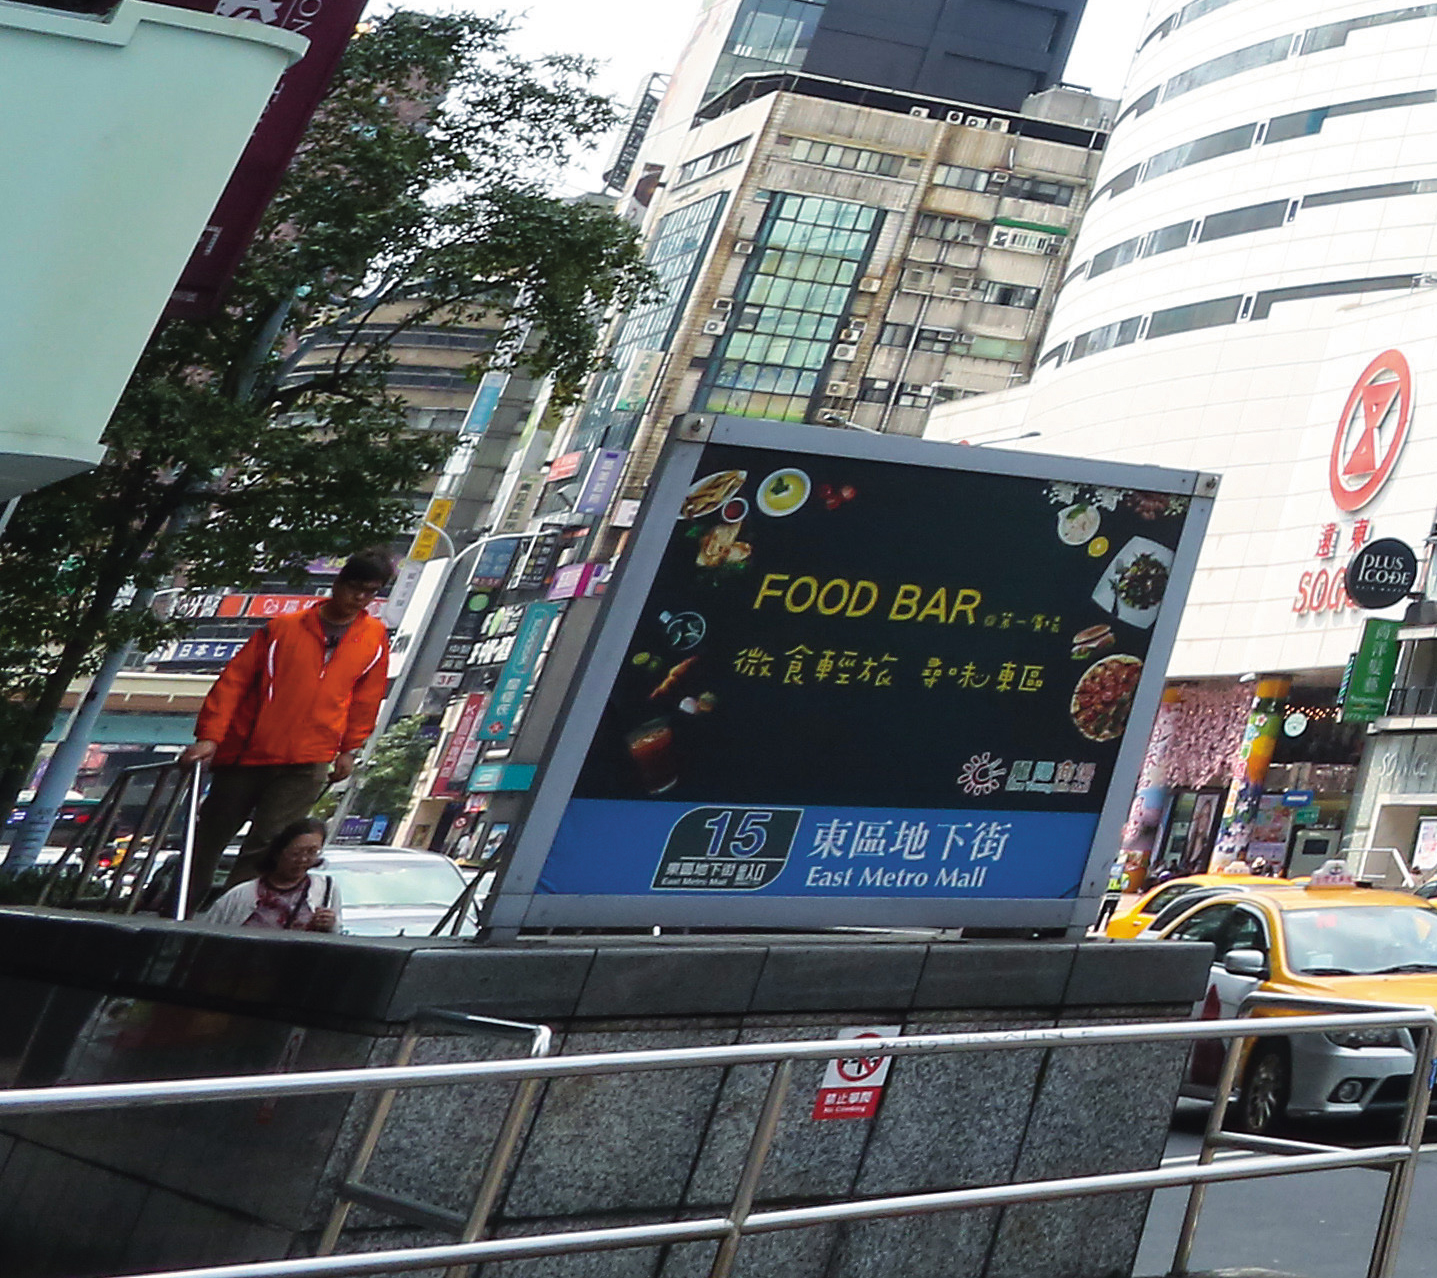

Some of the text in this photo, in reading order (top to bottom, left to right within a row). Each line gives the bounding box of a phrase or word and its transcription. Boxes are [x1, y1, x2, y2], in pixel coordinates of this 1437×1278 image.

[1314, 518, 1375, 559] 遠東
[752, 573, 983, 626] FOOD BAR
[1291, 567, 1357, 617] SOG
[703, 810, 773, 858] 15
[805, 818, 1013, 862] 東區地下街
[805, 866, 987, 889] East Metro Mall
